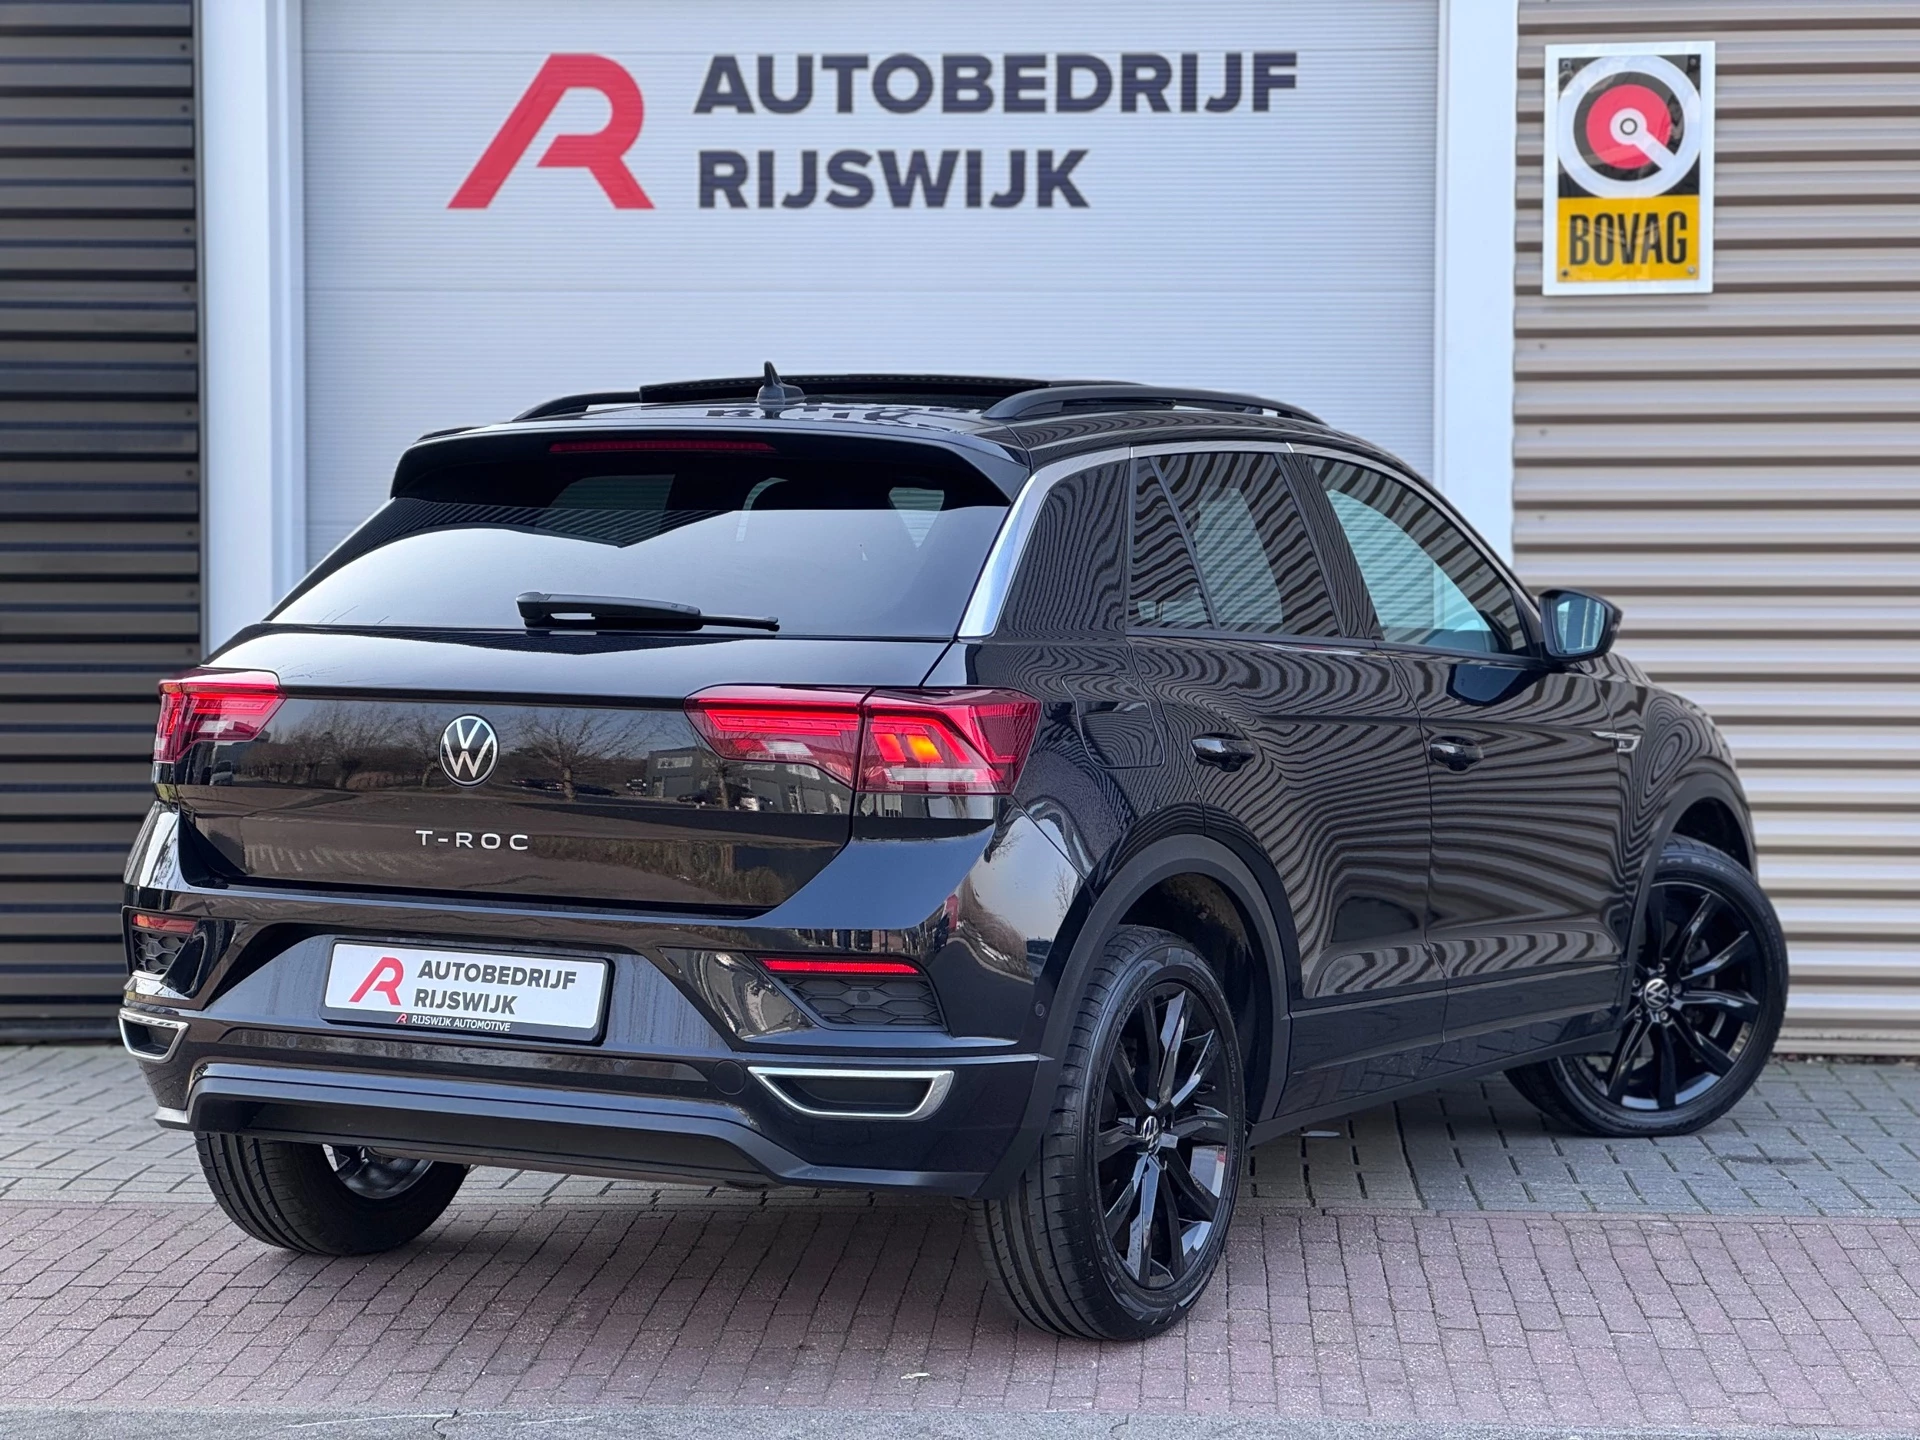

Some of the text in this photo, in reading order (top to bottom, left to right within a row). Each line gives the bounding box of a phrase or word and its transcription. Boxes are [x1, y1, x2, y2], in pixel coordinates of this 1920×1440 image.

[693, 51, 1298, 115] AUTOBEDRIJF
[698, 149, 1090, 210] RIJSWIJK
[1569, 211, 1688, 266] BOVAG
[415, 829, 529, 851] T-ROC
[416, 959, 577, 990] AUTOBEDRIJF
[413, 988, 518, 1015] RIJSWIJK
[411, 1015, 452, 1027] RIJSWIJK
[453, 1017, 511, 1032] AUTOMOTIVE
